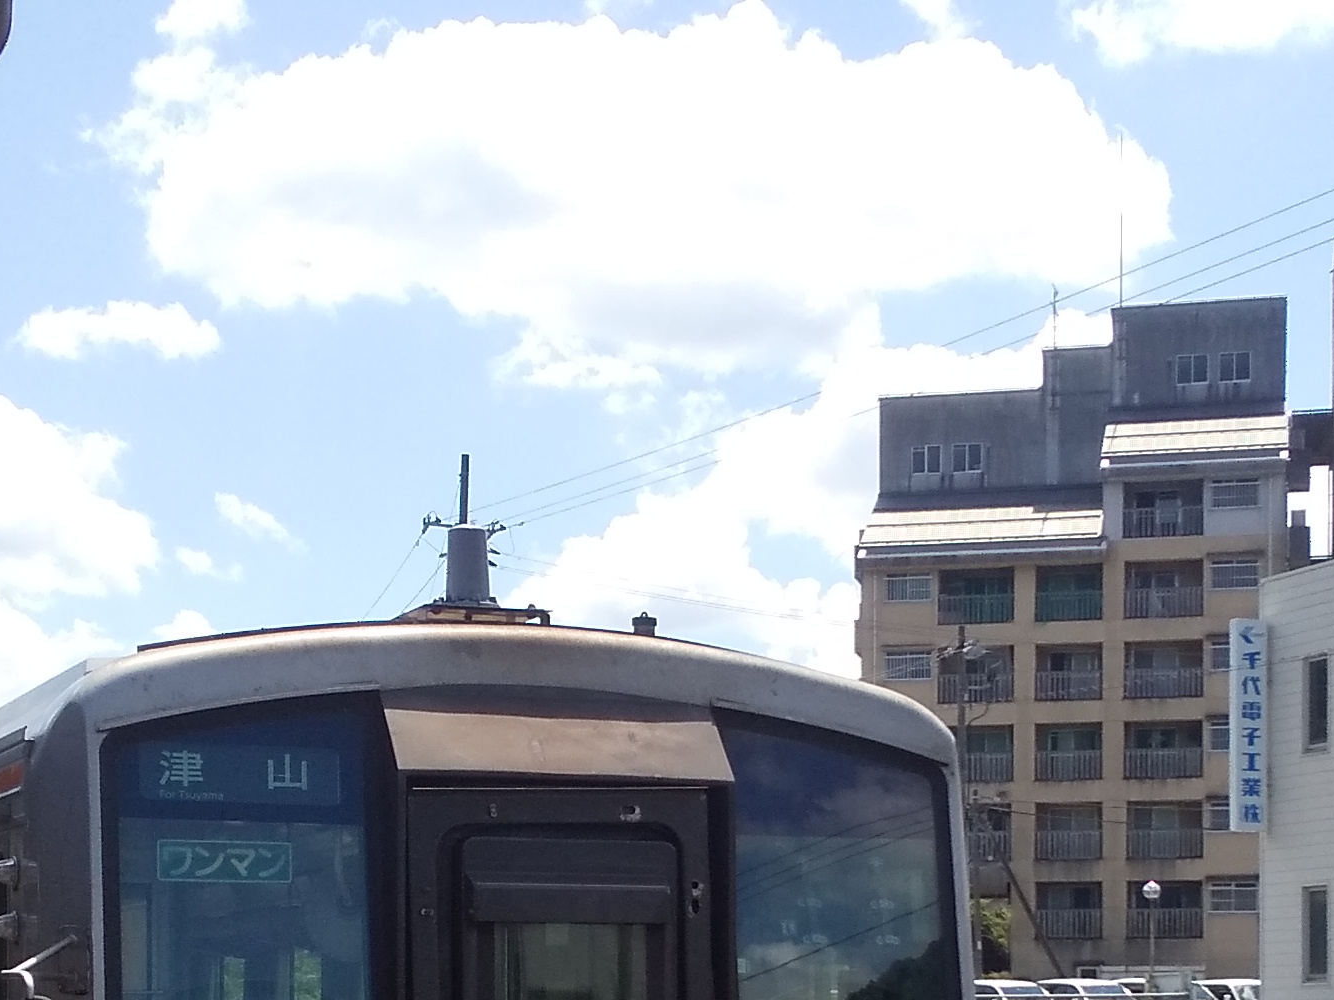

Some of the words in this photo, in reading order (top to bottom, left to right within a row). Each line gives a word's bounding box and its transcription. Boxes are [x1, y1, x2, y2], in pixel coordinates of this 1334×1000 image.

[159, 789, 176, 799] For
[178, 790, 225, 801] Tsuyama
[163, 845, 287, 877] ワンマン
